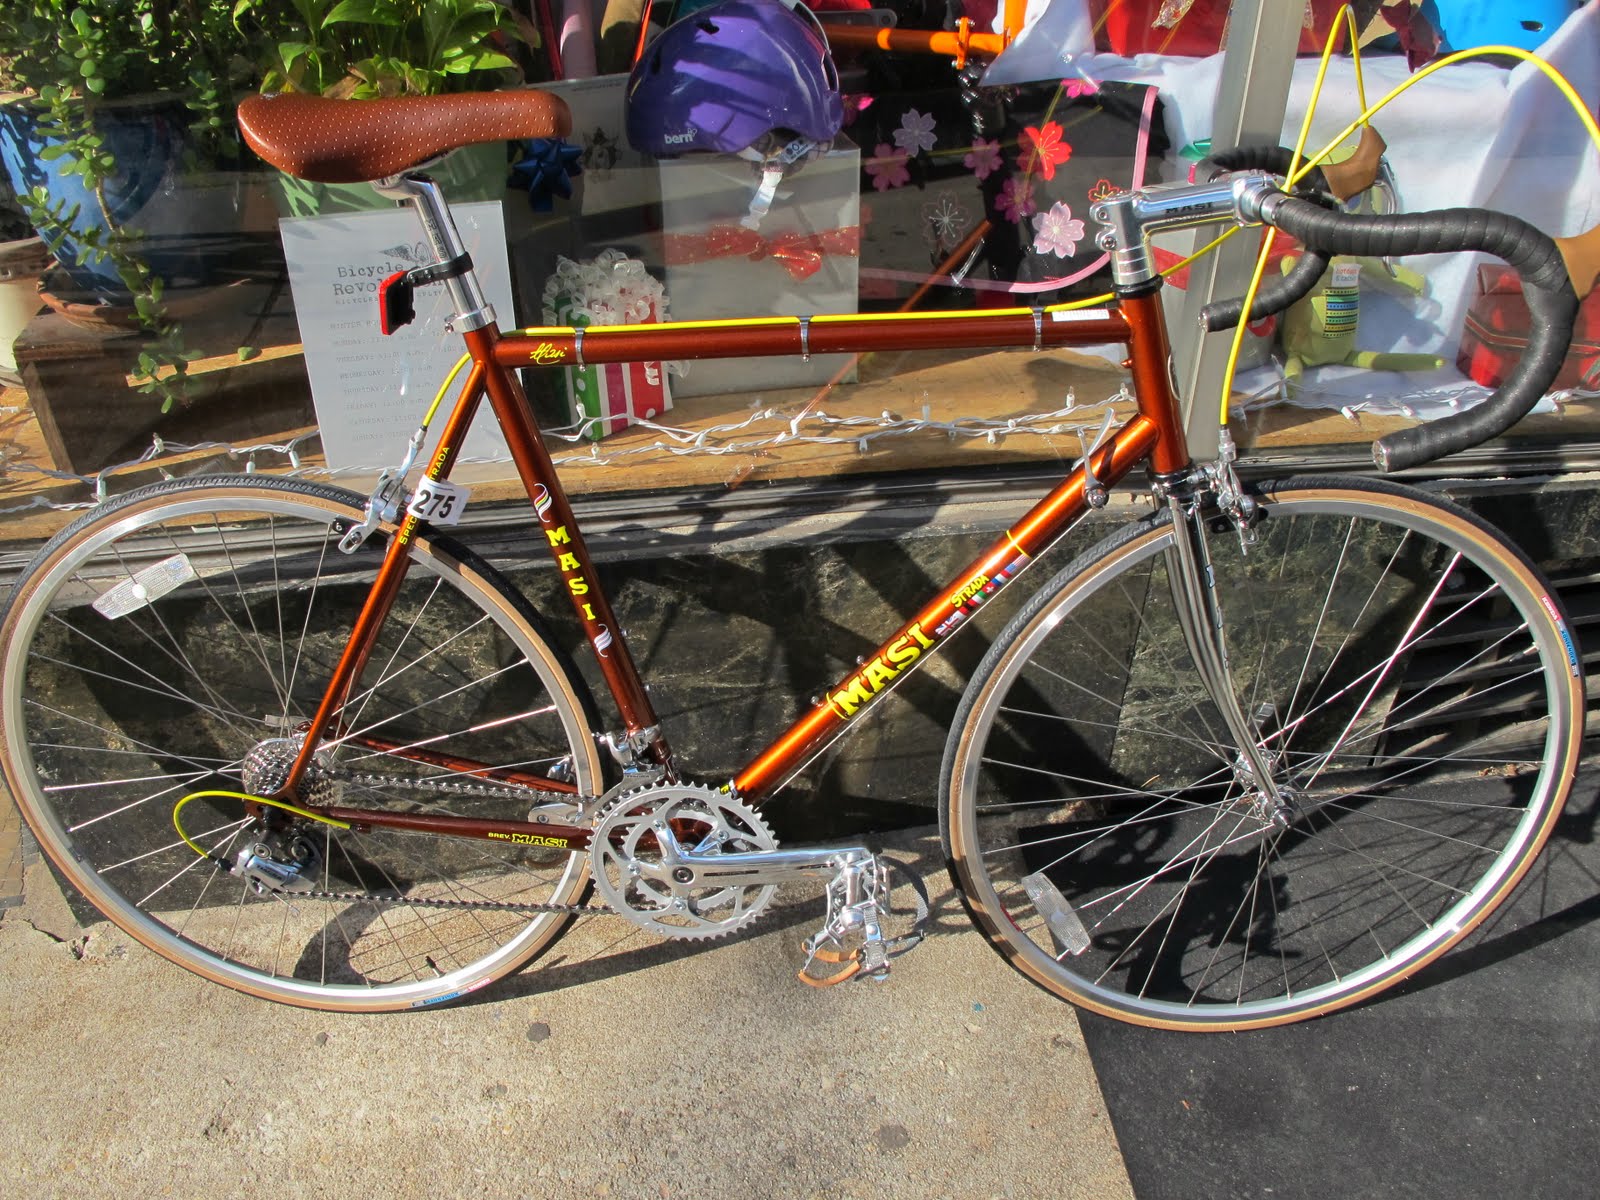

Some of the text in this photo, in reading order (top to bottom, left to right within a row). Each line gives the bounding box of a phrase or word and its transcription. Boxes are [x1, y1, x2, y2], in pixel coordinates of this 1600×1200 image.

[664, 134, 694, 144] bern
[1165, 201, 1214, 214] MASI
[337, 262, 404, 278] Bicycle
[412, 489, 457, 519] 275
[545, 525, 597, 621] MASI
[951, 574, 990, 608] STRADA
[832, 622, 935, 716] MASI
[488, 832, 568, 848] BREV. MASI
